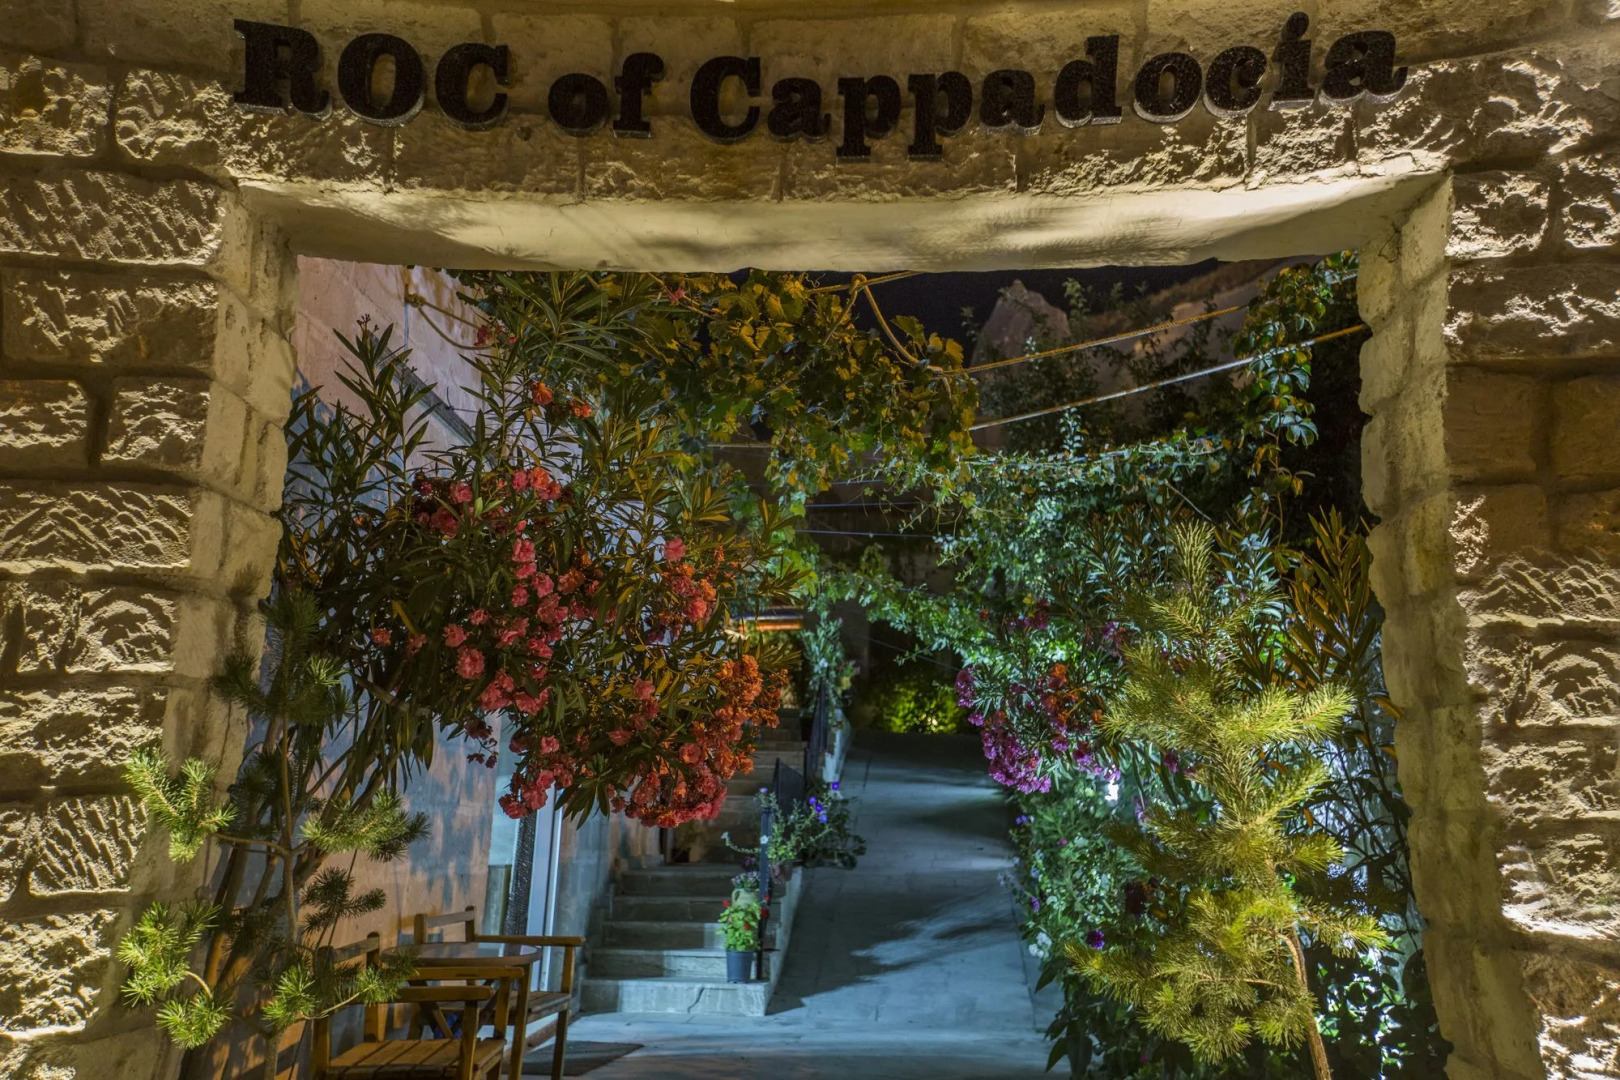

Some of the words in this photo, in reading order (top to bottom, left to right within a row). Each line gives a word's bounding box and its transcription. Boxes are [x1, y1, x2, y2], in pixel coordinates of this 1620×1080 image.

[233, 19, 509, 130] ROC
[547, 52, 665, 138] of
[690, 12, 1408, 163] Cappadocia
